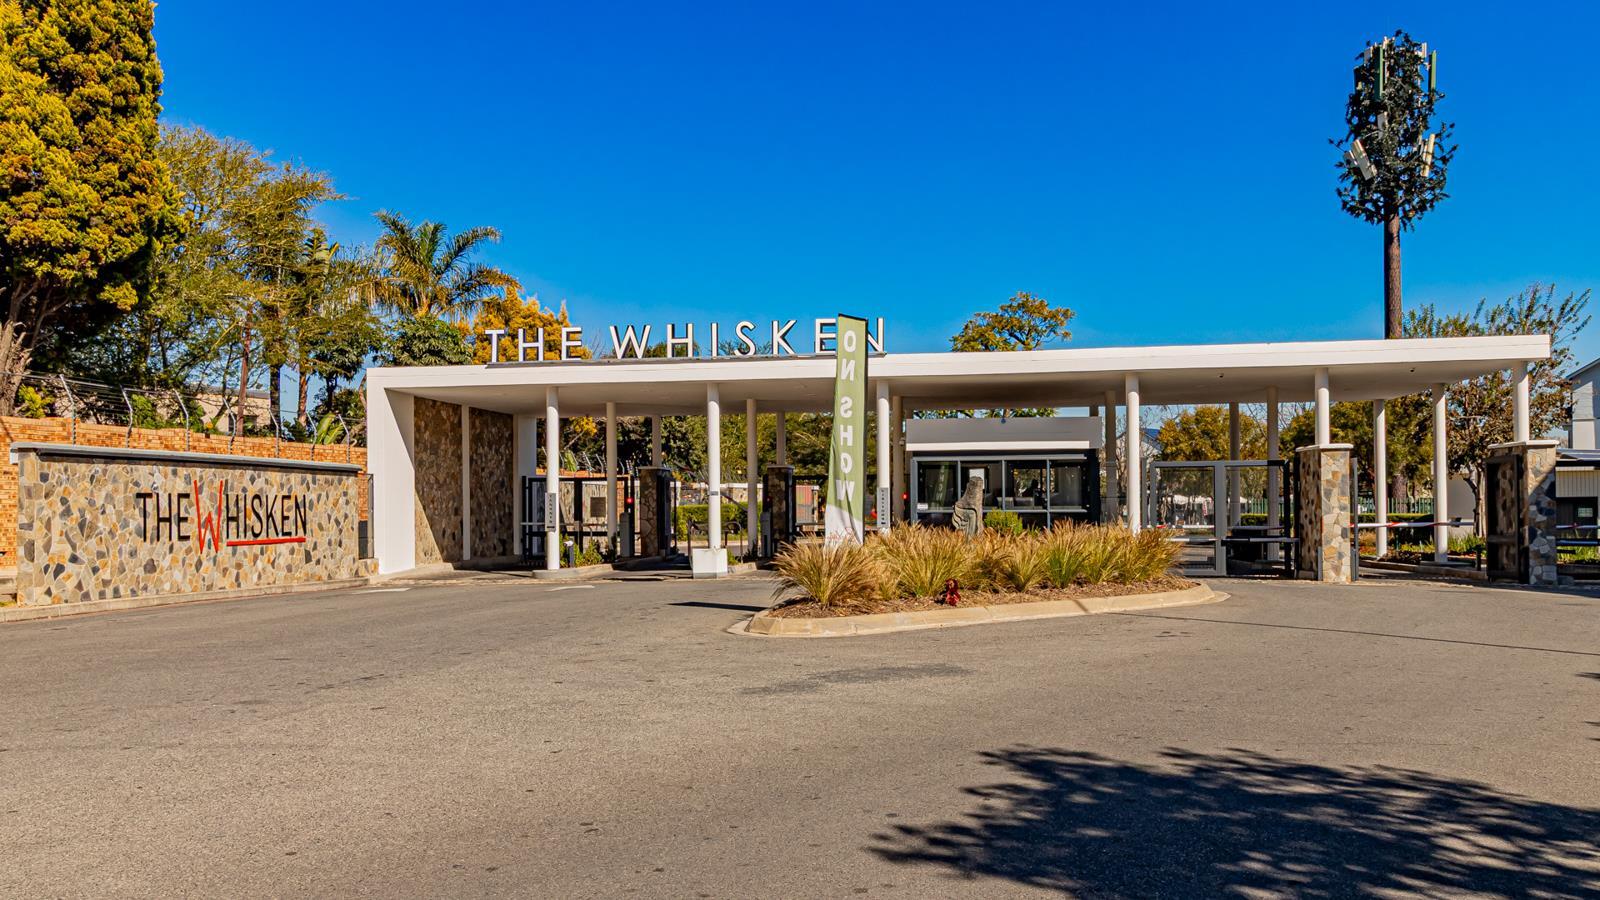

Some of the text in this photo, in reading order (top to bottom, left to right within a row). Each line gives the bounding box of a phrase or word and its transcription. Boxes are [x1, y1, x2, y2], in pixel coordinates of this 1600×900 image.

[485, 318, 885, 362] THE WHISKEN
[136, 480, 306, 554] THE WHISKEN
